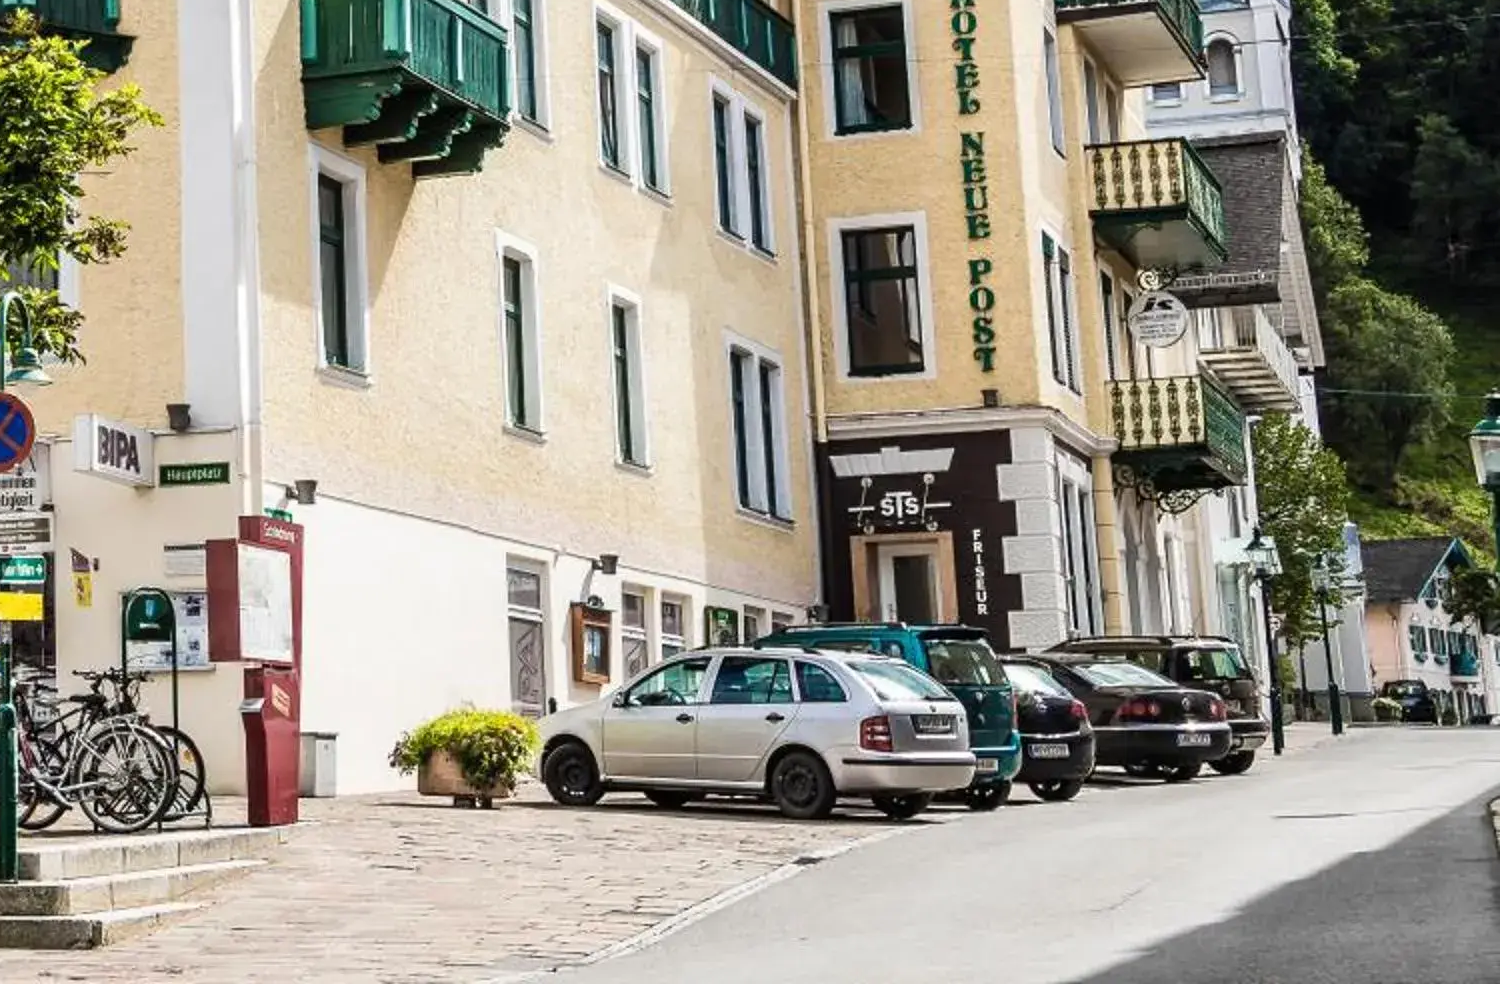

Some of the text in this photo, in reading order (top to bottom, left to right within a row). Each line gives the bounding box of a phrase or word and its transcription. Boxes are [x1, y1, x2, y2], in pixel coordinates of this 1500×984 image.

[960, 131, 991, 239] NEUE
[968, 259, 997, 373] POST
[98, 425, 140, 474] BIPA
[167, 468, 222, 482] Hauptplatz
[881, 491, 919, 518] STS
[972, 529, 988, 615] FRISEUR
